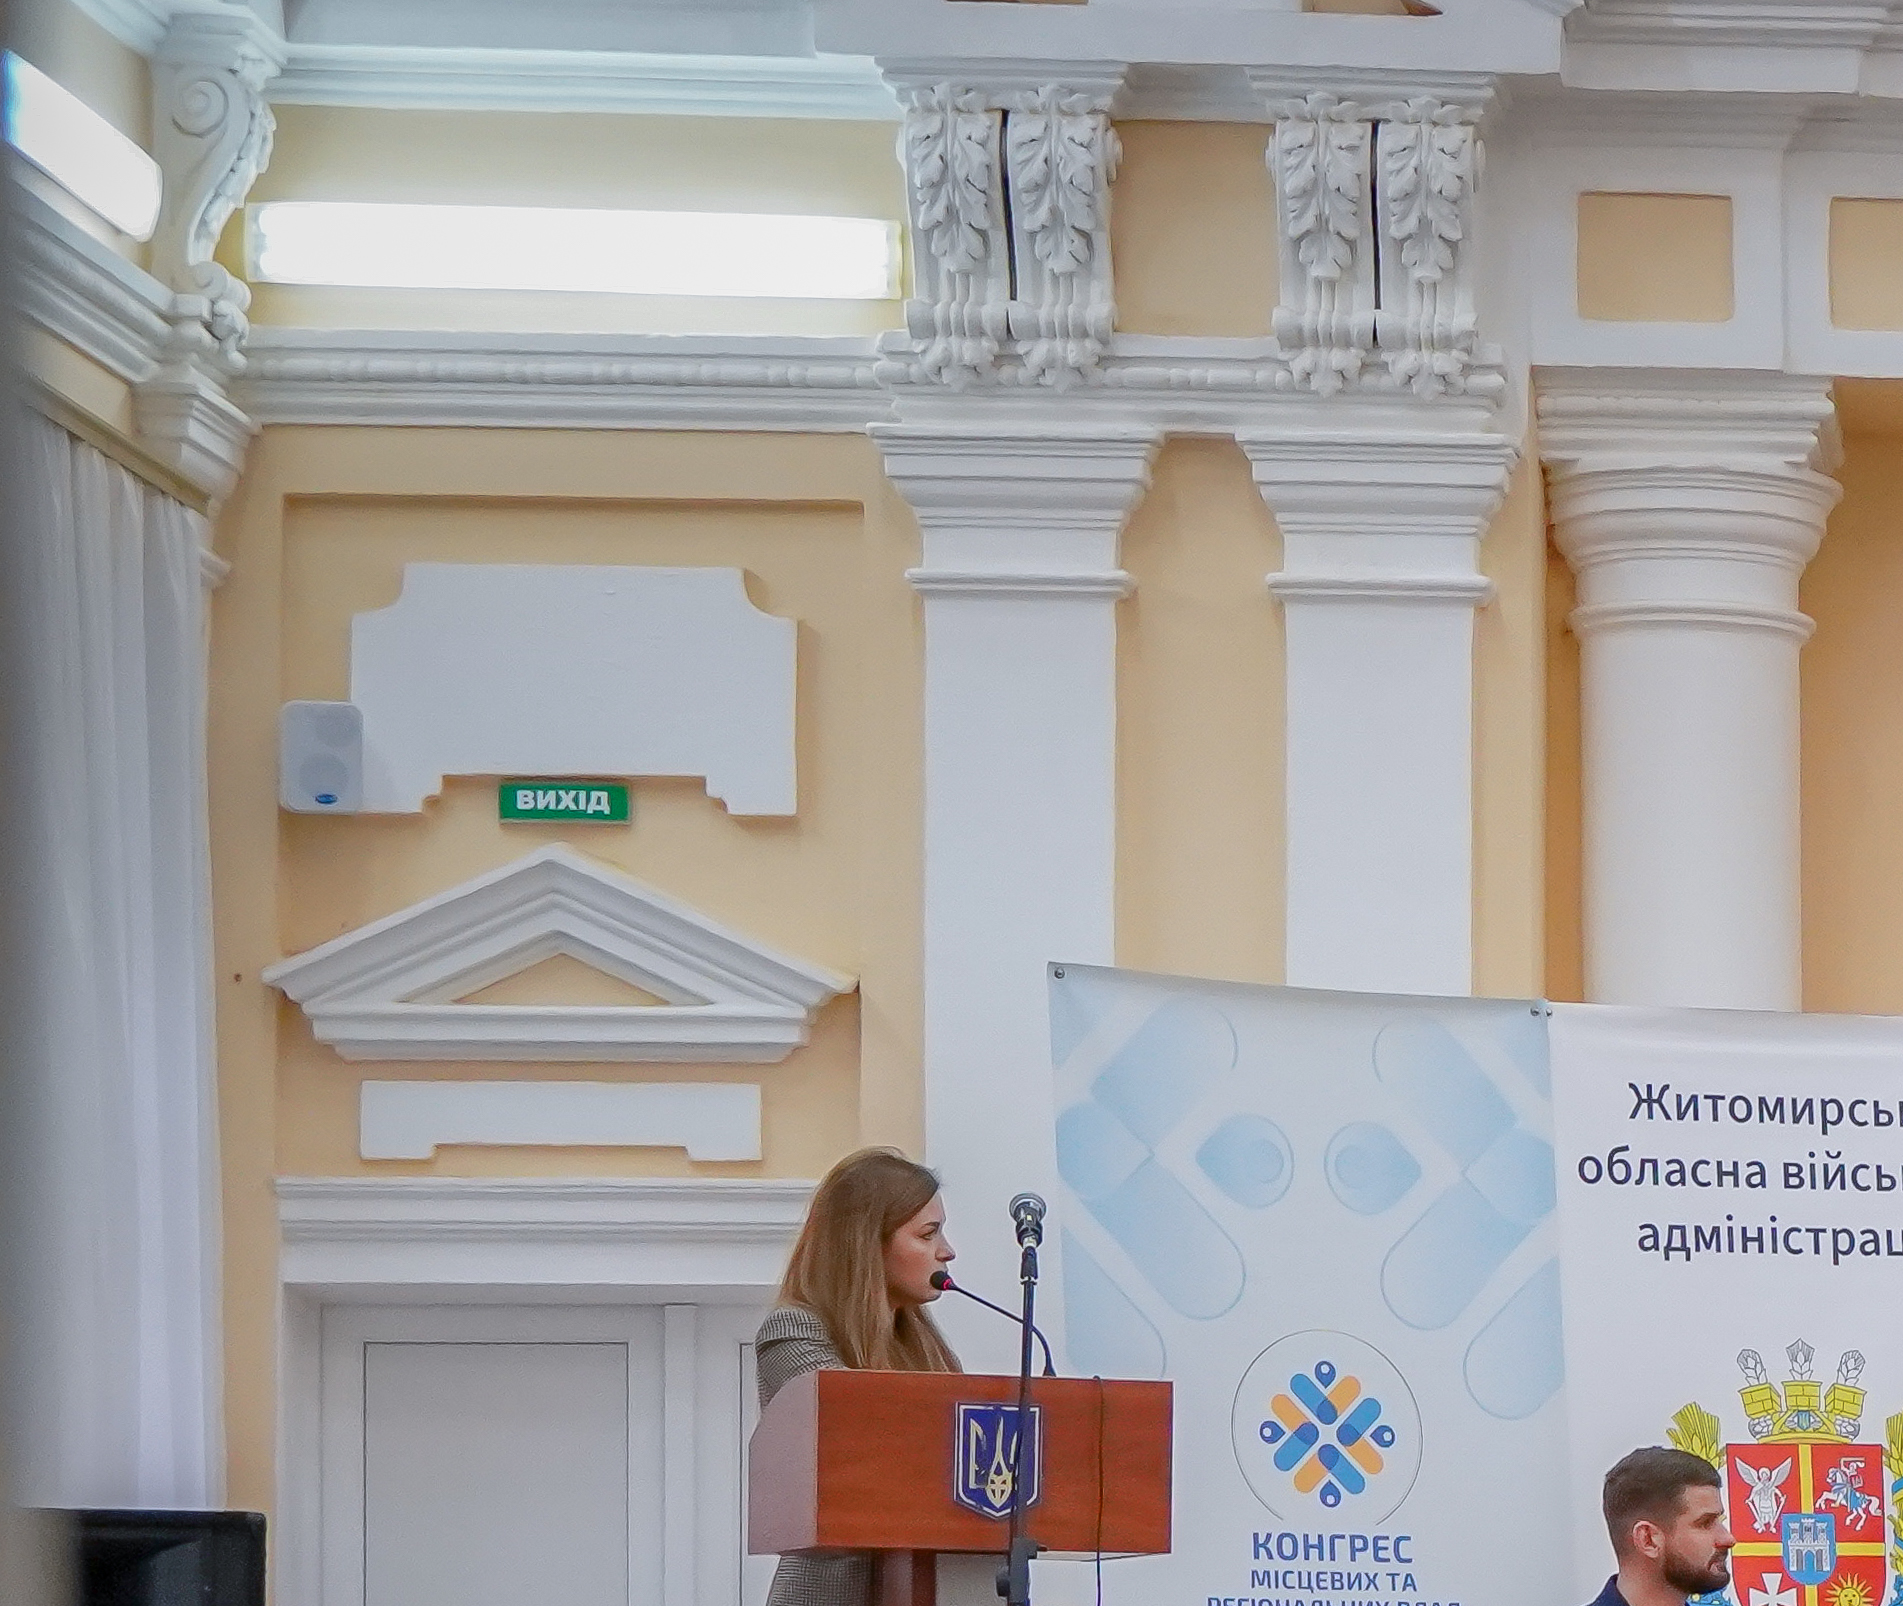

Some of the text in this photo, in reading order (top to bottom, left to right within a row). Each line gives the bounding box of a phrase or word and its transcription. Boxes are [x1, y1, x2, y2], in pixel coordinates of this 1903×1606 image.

[517, 789, 610, 814] ВИХІД
[1579, 1145, 1766, 1188] обласна
[1253, 1532, 1412, 1563] КОНГРЕС
[1252, 1570, 1417, 1593] МІСЦЕВИХ ТА
